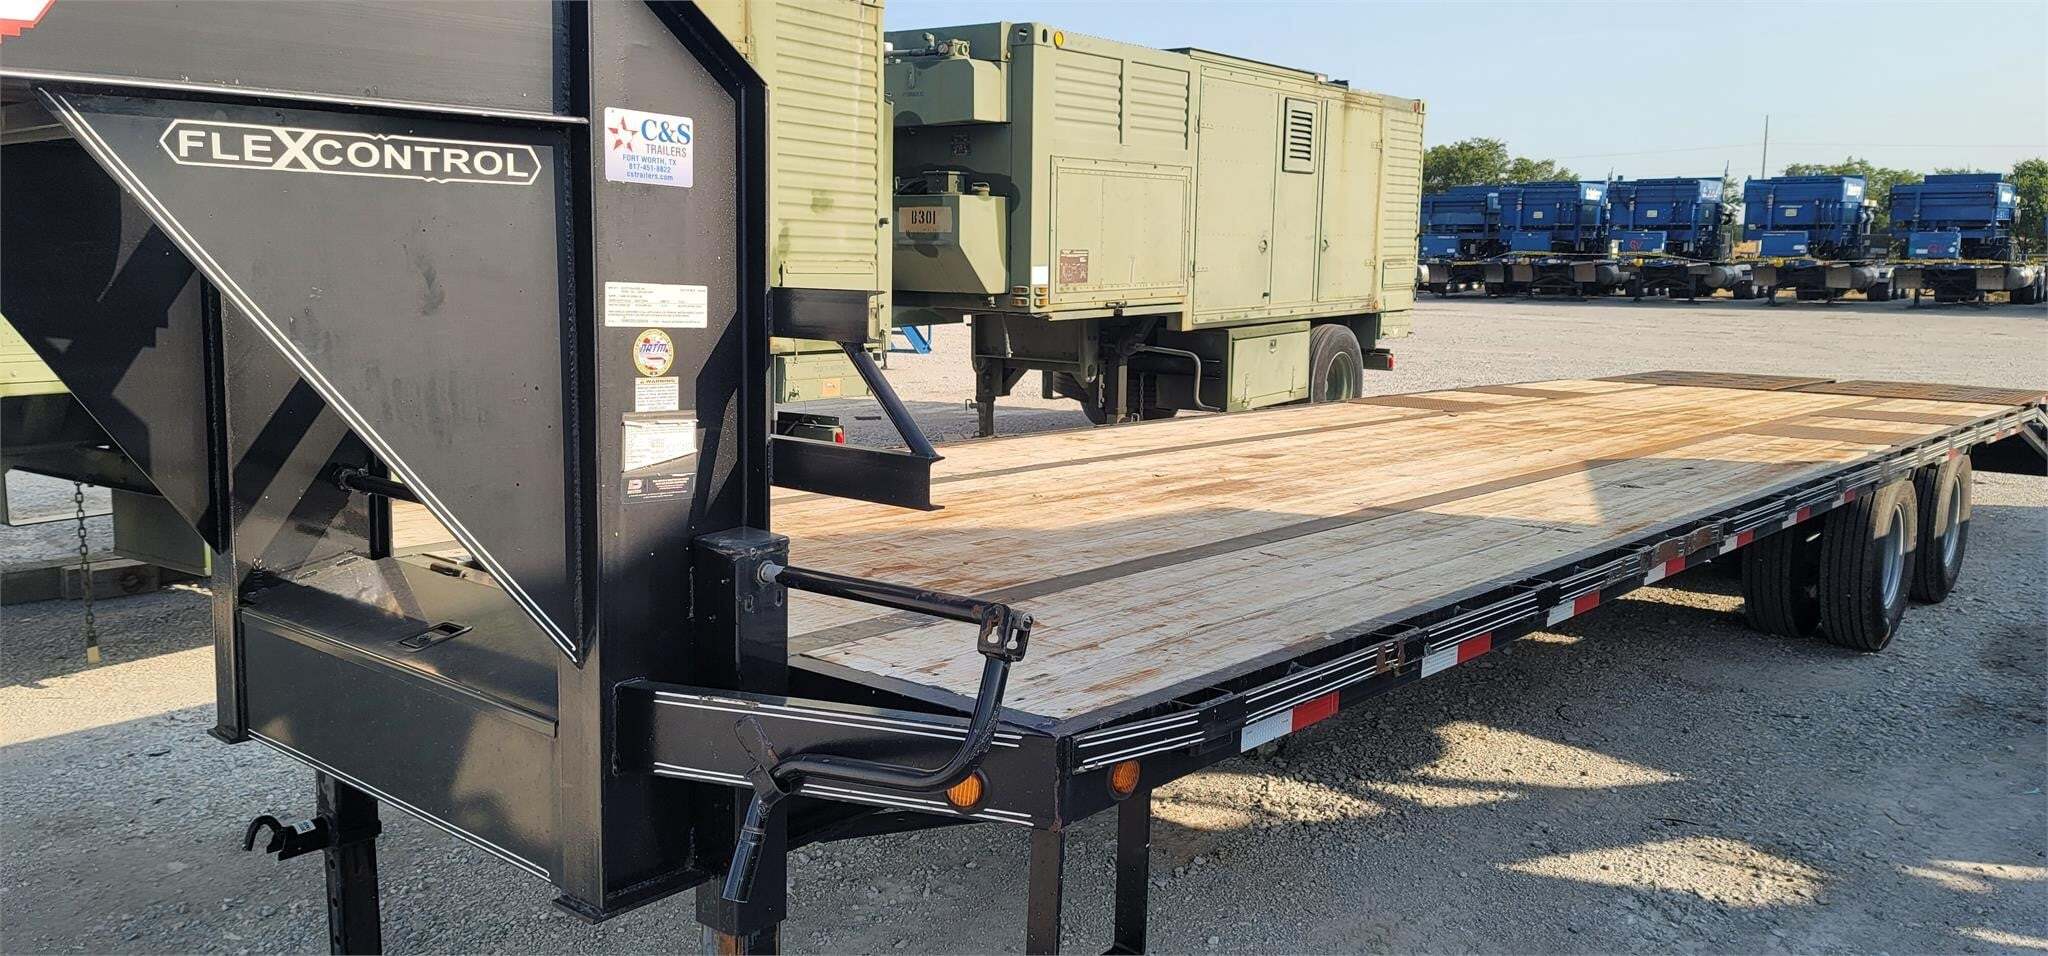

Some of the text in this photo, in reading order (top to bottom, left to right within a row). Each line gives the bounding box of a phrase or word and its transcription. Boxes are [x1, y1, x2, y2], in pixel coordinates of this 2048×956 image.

[641, 119, 691, 145] C&S
[178, 129, 529, 178] FLEXCONTROL
[646, 144, 687, 157] TRAILERS
[623, 154, 639, 162] FORT
[641, 156, 667, 165] WORTH,
[627, 171, 673, 180] cstrailers.com
